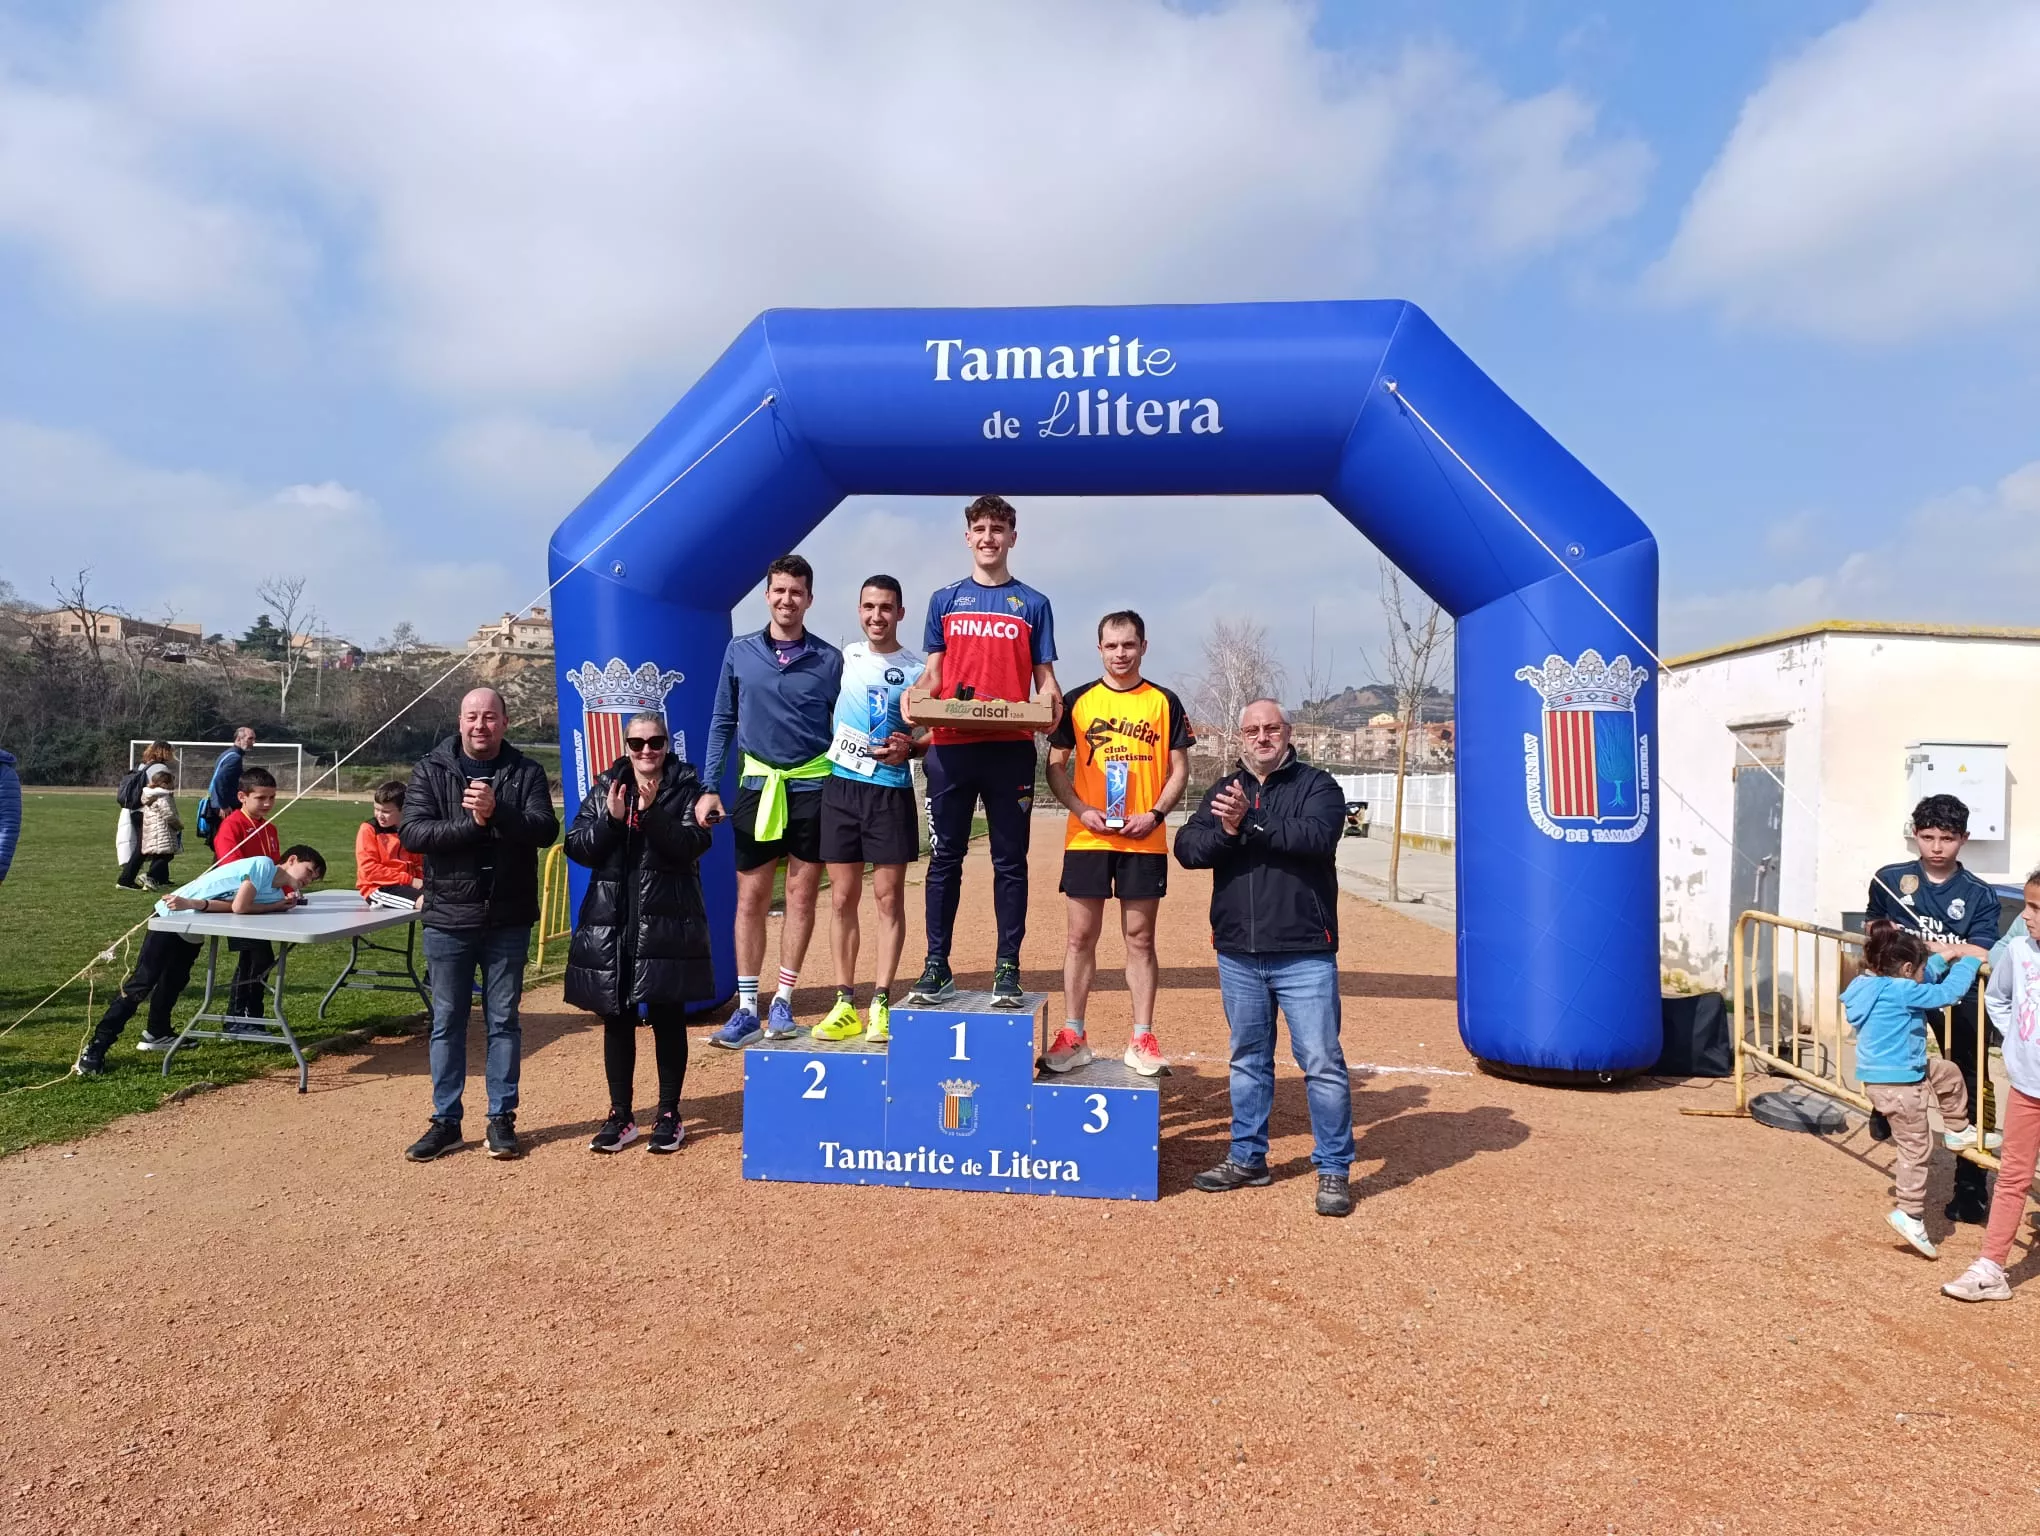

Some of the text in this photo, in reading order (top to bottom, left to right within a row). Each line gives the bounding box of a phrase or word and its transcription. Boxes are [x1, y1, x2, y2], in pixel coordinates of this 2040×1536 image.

[926, 335, 1176, 381] Tamarite
[983, 389, 1224, 439] de Llitera
[950, 619, 1019, 640] HINACO
[972, 705, 1009, 718] alsat
[1104, 745, 1127, 753] club
[1105, 753, 1153, 761] atletismo
[1524, 733, 1562, 839] AYUNTAMIENTO
[1567, 830, 1588, 841] DE
[1920, 916, 1943, 932] Fly
[949, 1021, 970, 1061] 1
[802, 1060, 827, 1099] 2
[1082, 1093, 1110, 1133] 3
[819, 1141, 1081, 1182] Tamarite de Litera
